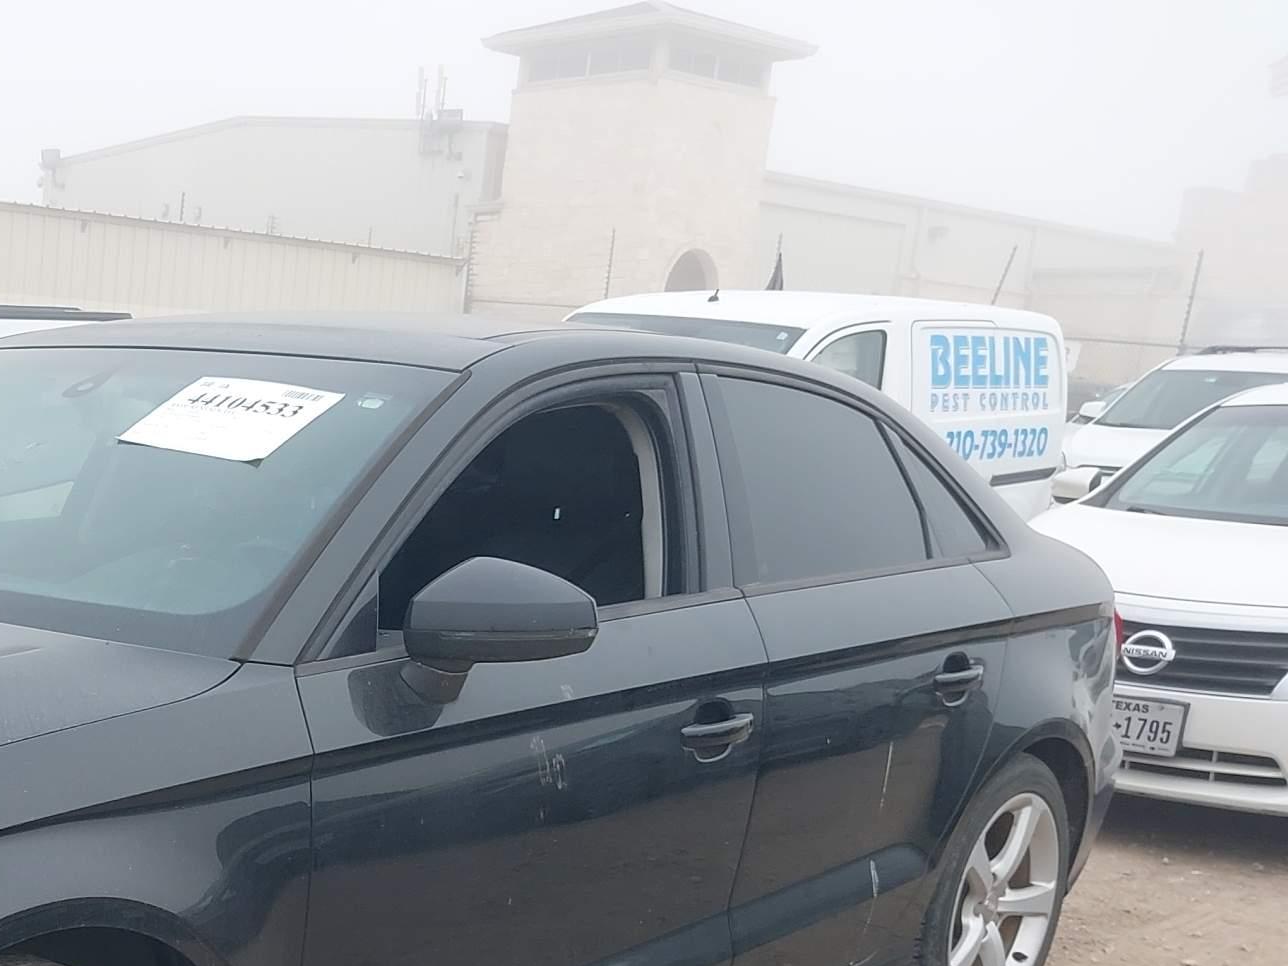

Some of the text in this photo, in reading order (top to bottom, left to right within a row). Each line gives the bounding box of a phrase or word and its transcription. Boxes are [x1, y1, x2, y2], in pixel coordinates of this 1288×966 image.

[929, 334, 1049, 389] BEELINE
[187, 392, 305, 418] 44104533
[929, 392, 1049, 412] PEST CONTROL
[1123, 647, 1168, 658] NISSAN
[1121, 716, 1173, 744] 1795
